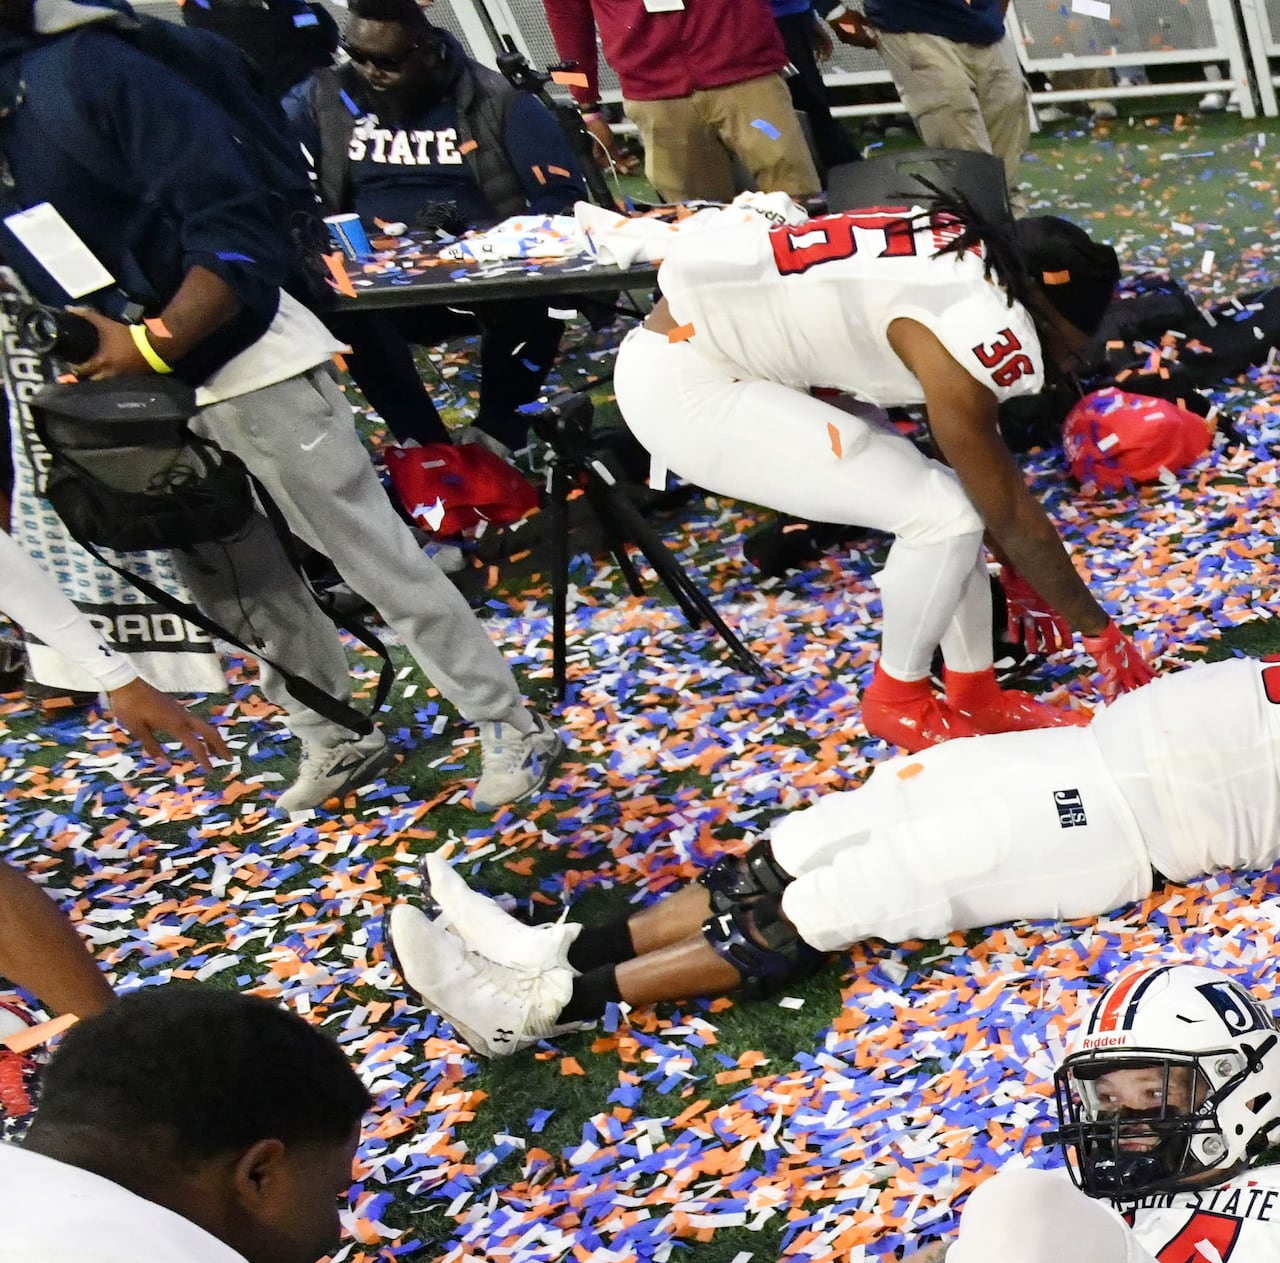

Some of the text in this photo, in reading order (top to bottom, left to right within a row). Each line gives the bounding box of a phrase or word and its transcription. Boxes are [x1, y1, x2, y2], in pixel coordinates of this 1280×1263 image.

[349, 127, 463, 165] STATE
[972, 327, 1035, 387] 36
[1082, 1035, 1127, 1050] Riddell
[1186, 1190, 1279, 1222] STATE
